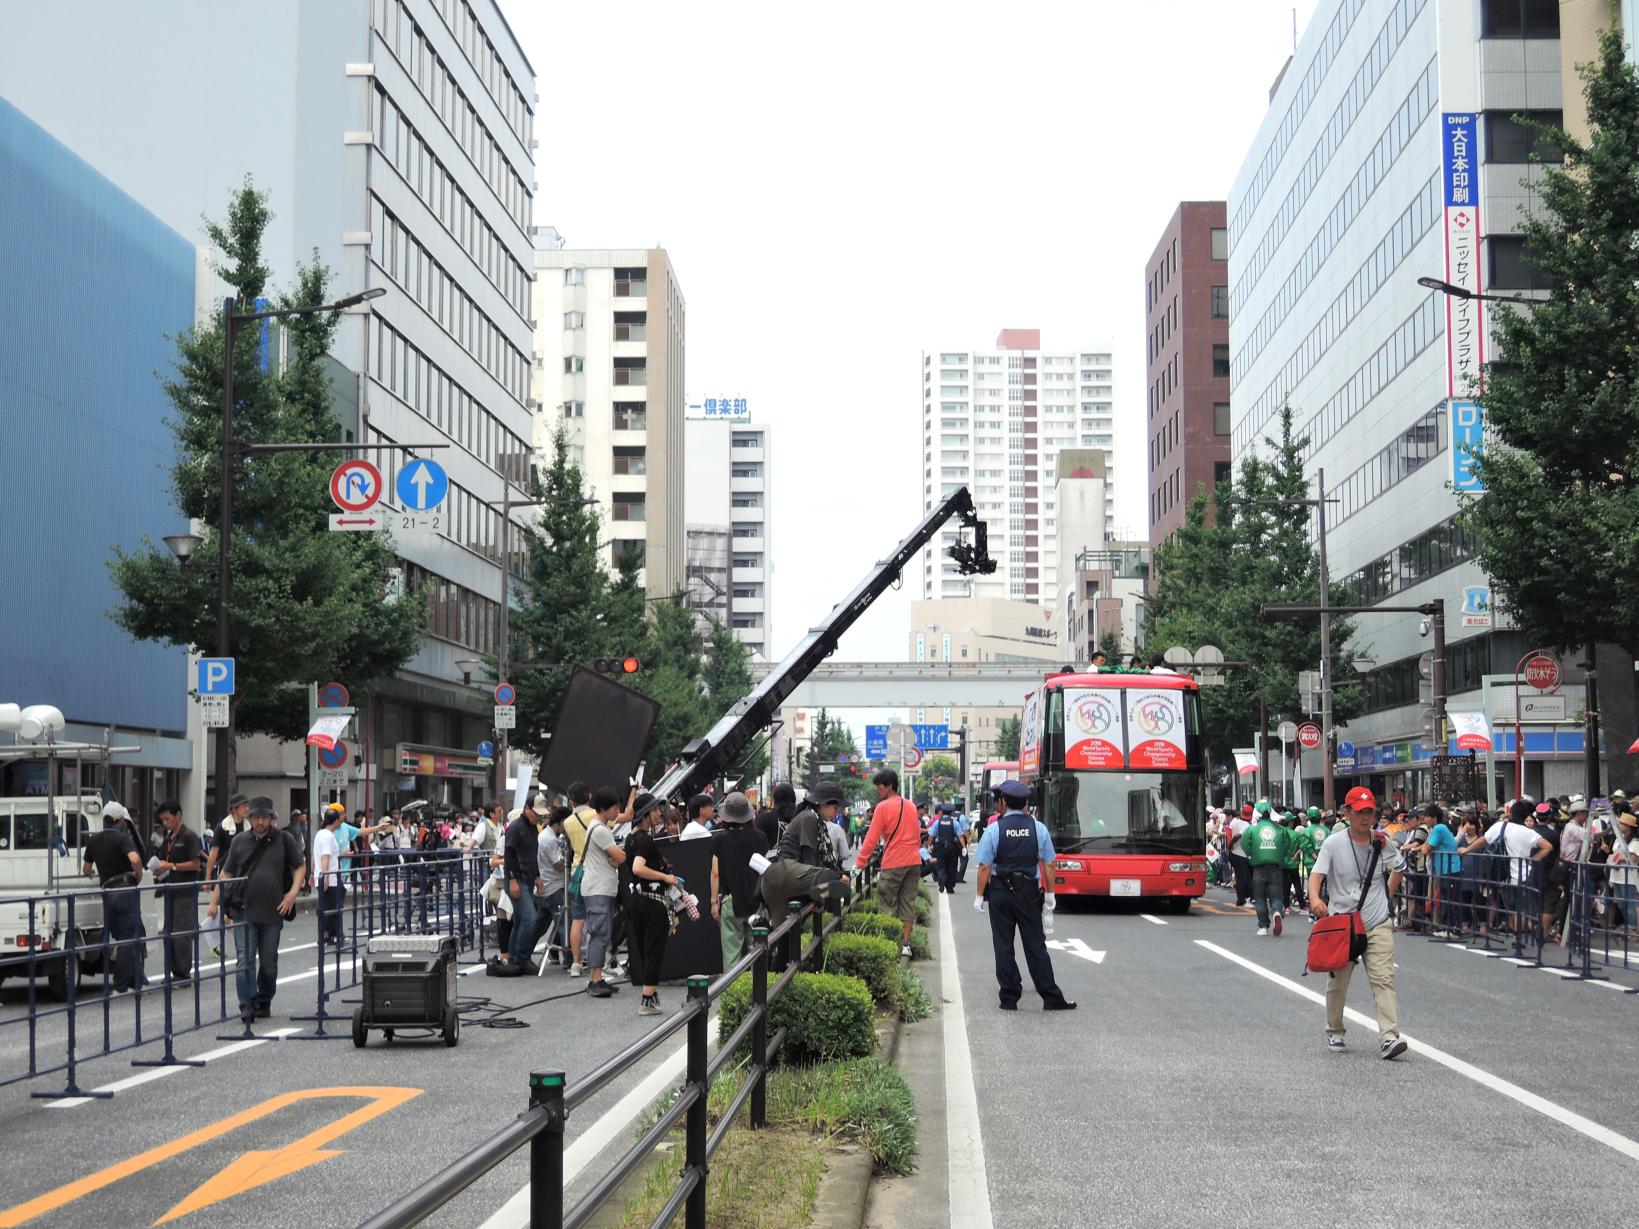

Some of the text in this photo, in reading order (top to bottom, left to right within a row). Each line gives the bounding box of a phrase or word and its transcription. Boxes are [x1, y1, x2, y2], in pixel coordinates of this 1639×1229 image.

[1447, 116, 1470, 125] DNP
[1451, 127, 1469, 204] 大日本印刷
[207, 662, 228, 691] P
[1526, 667, 1557, 680] 防火水そう
[25, 785, 49, 795] ATM
[1006, 828, 1030, 838] POLICE
